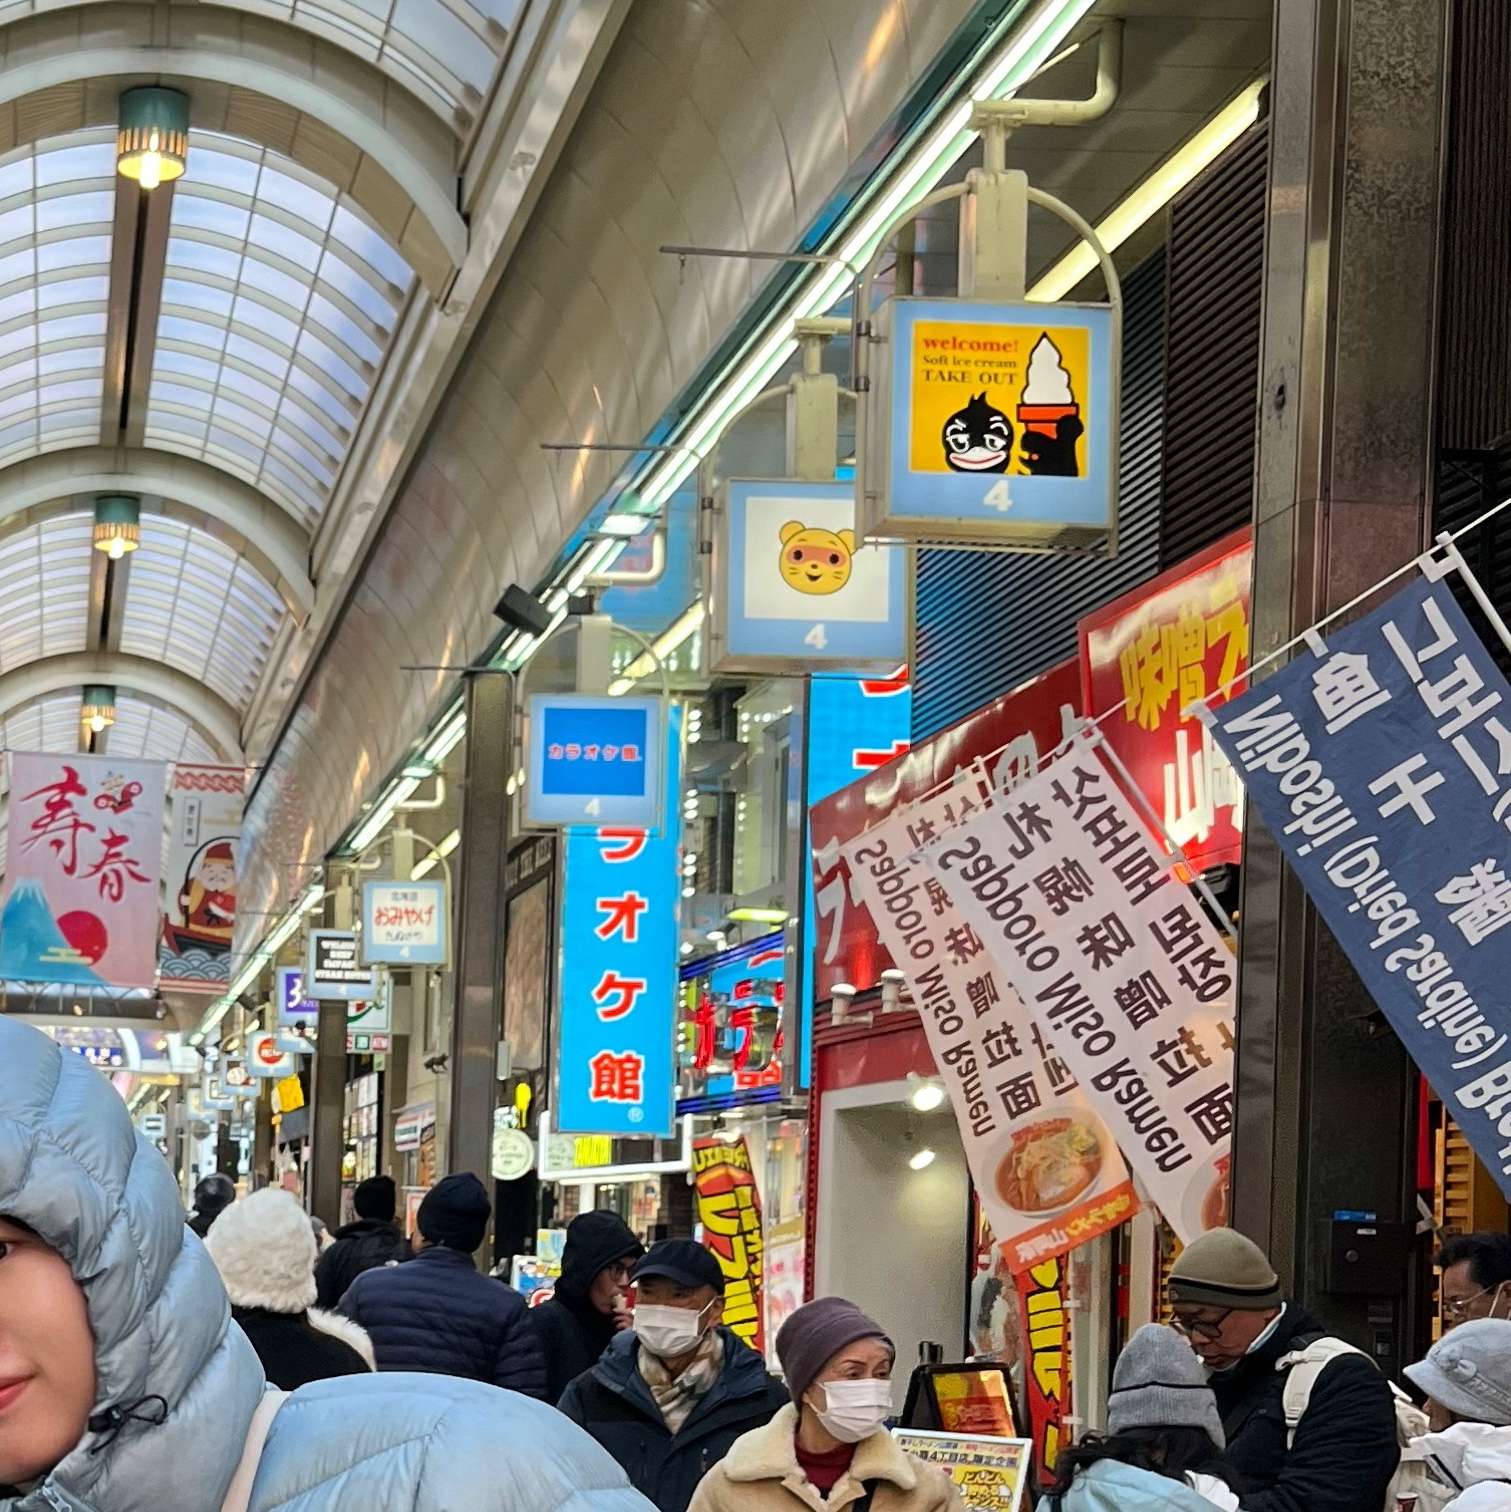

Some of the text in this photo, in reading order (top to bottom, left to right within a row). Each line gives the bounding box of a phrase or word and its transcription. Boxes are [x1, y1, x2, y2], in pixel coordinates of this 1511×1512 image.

[923, 336, 1019, 352] welcome!
[922, 355, 949, 367] Soft
[974, 359, 1017, 368] cream
[922, 369, 1018, 385] TAKE OUT
[983, 479, 1013, 511] 4
[804, 623, 829, 650] 4
[585, 799, 602, 816] 4
[374, 905, 435, 927] おみやげ
